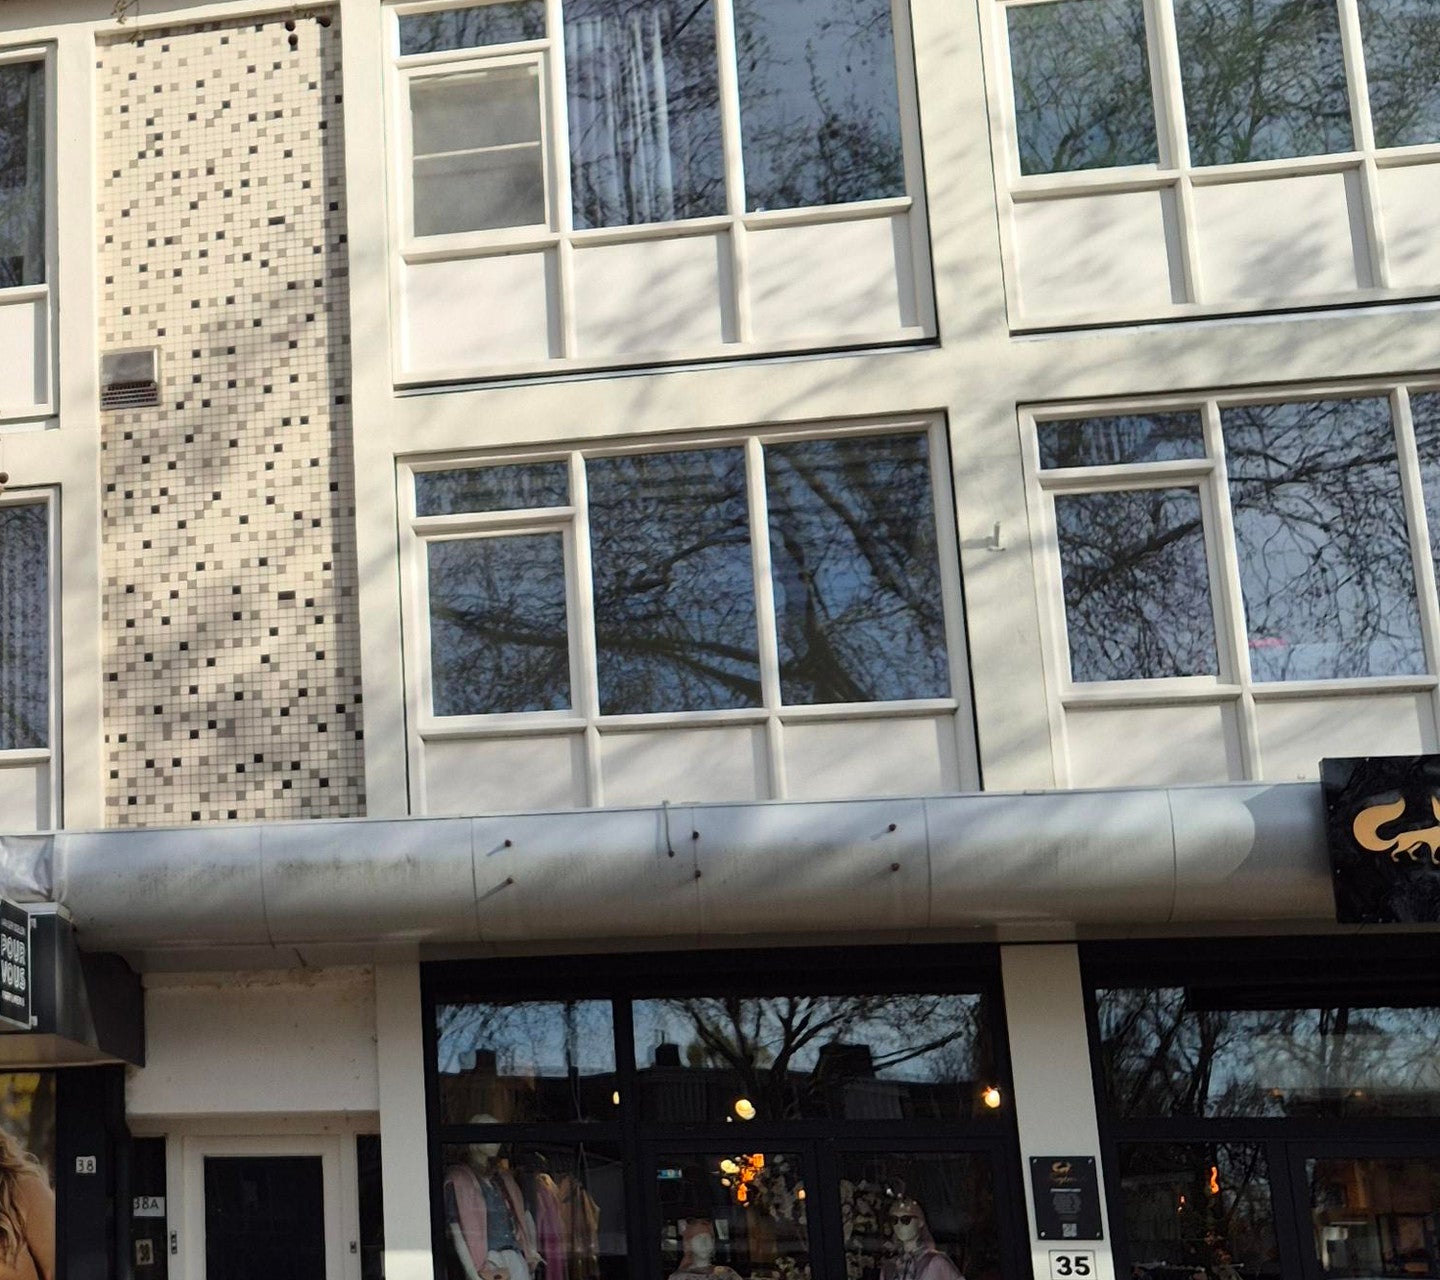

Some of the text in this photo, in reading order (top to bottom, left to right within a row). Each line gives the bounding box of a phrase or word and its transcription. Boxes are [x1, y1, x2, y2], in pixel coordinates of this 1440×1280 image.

[0, 932, 26, 966] POUR
[0, 959, 26, 991] VOUS
[77, 1160, 94, 1172] 38
[133, 1196, 159, 1210] 38A
[1055, 1255, 1091, 1276] 35
